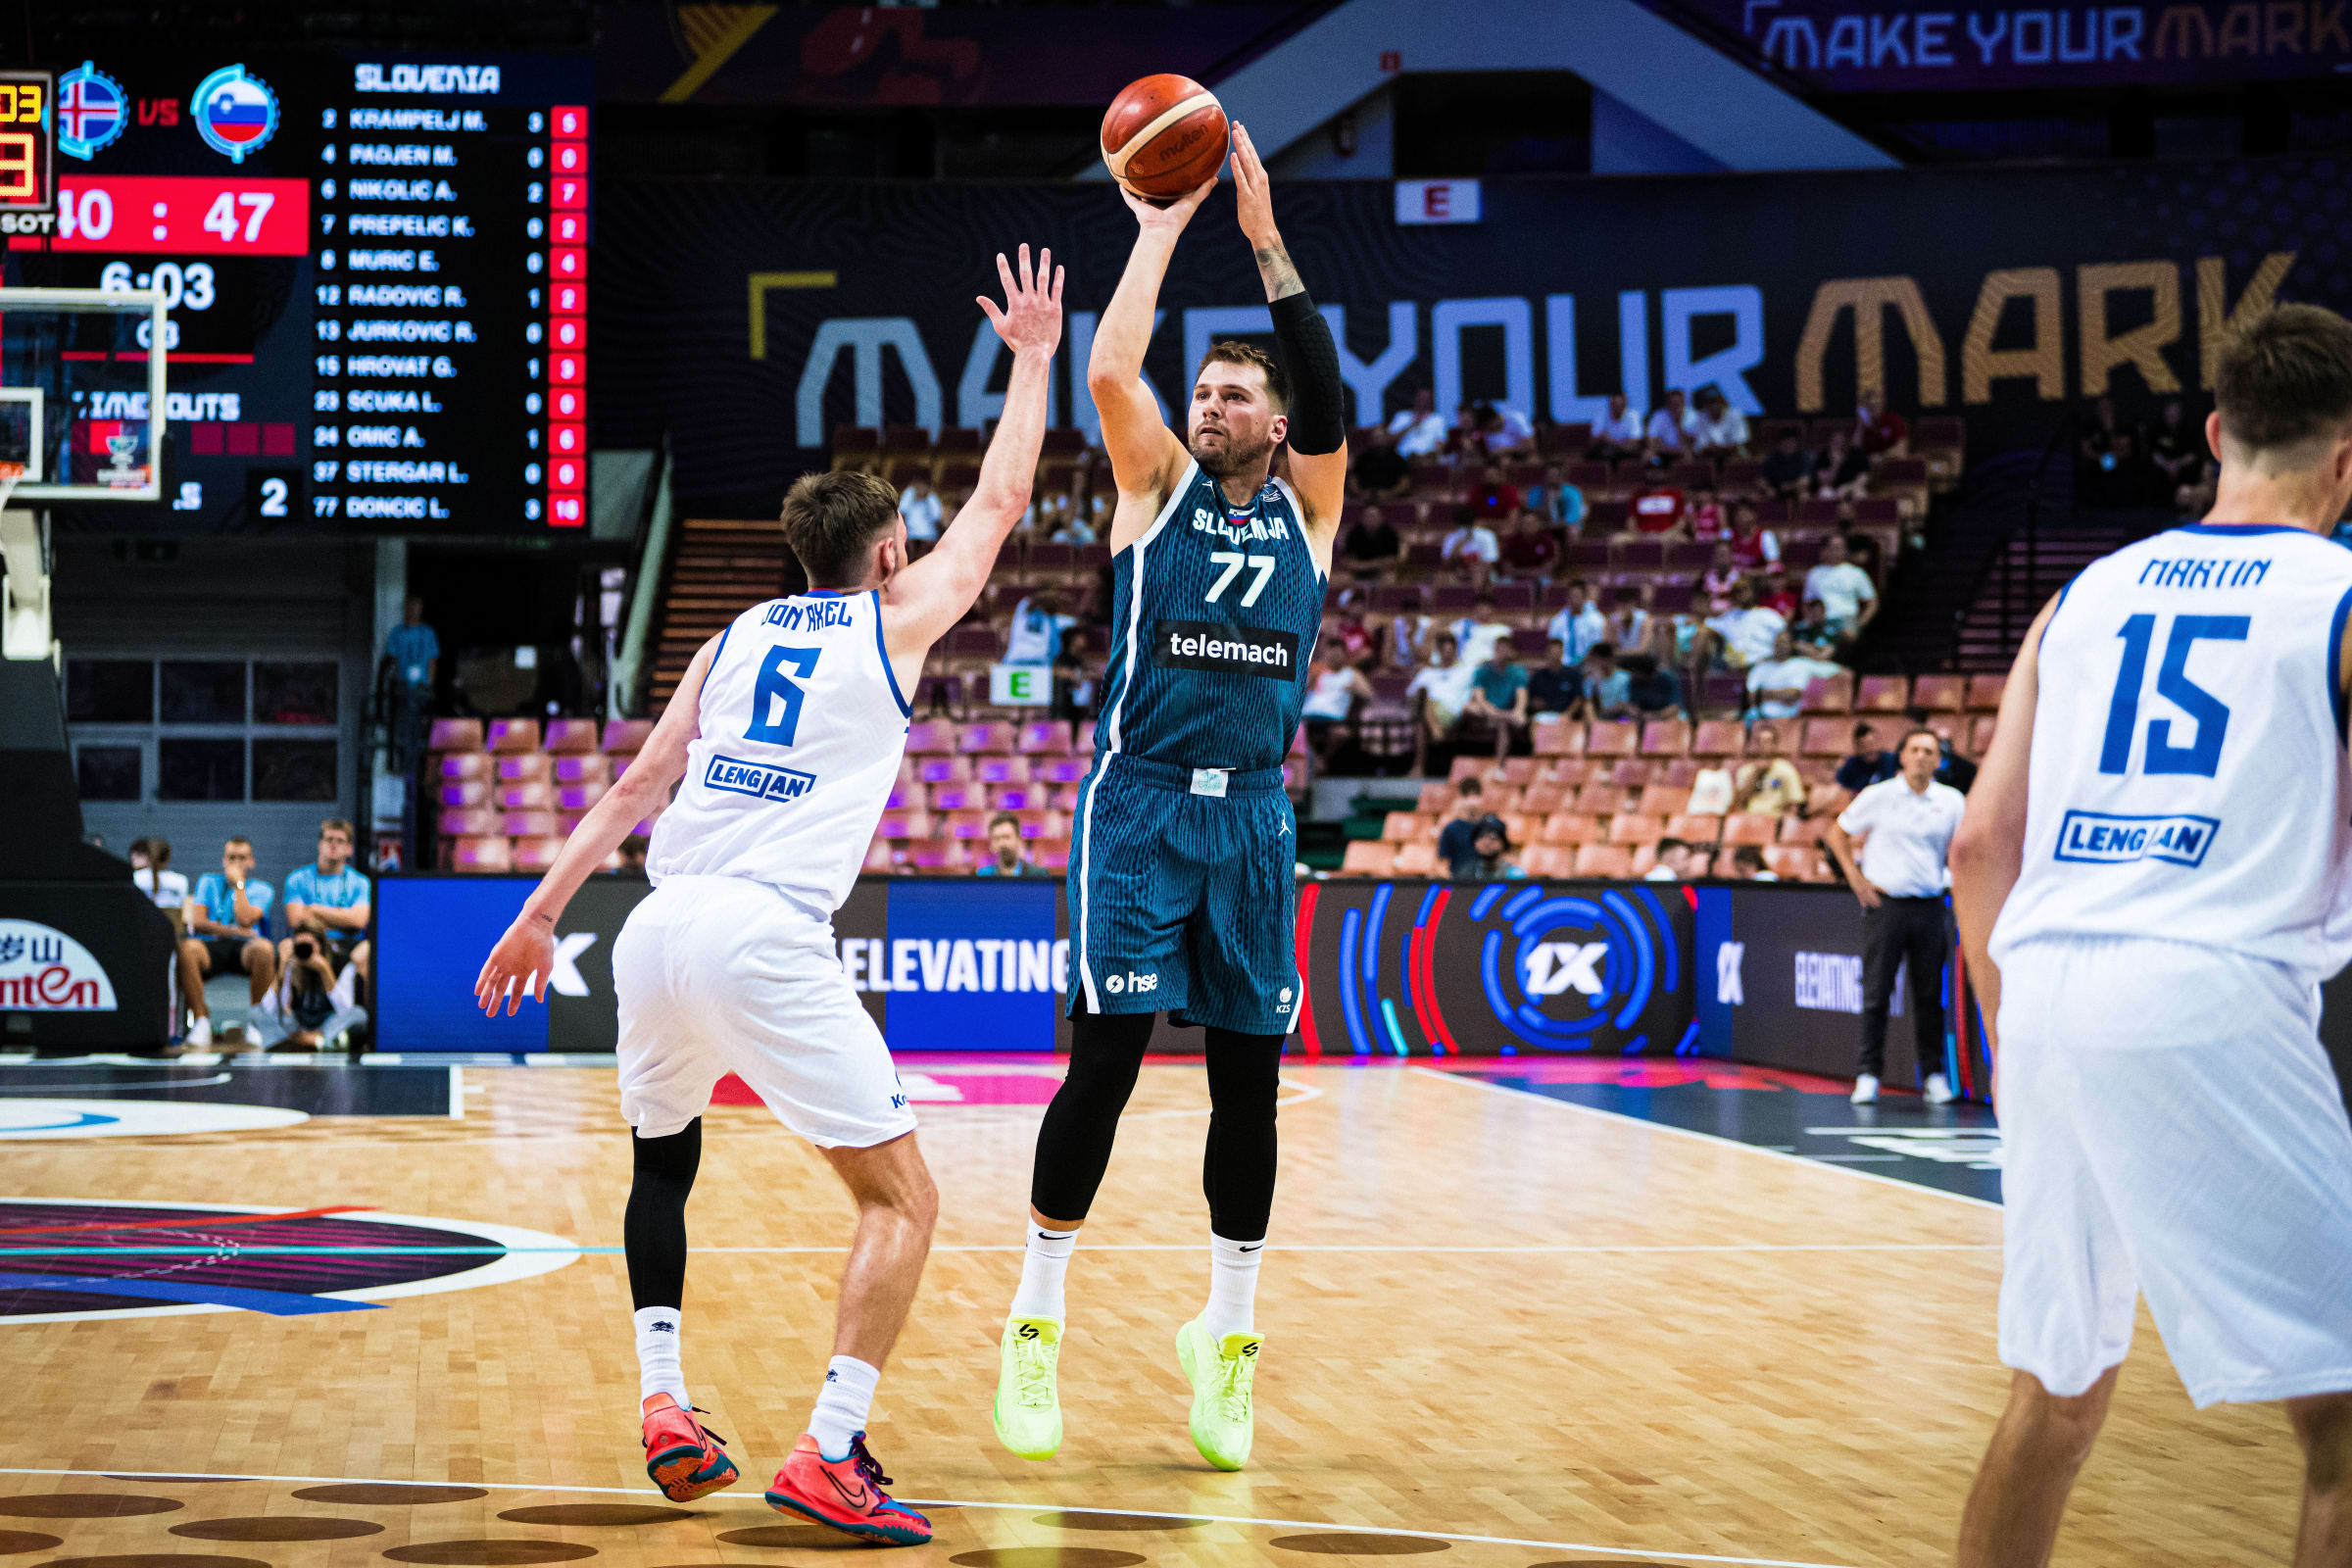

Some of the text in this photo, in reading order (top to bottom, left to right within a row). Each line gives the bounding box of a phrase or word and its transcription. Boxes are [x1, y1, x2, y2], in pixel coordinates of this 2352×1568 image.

[1764, 3, 2351, 68] MAKE YOUR MARK
[355, 64, 500, 94] SLOVENIA
[137, 98, 180, 126] VS
[321, 144, 336, 164] 4
[1160, 123, 1209, 162] molten
[349, 179, 432, 201] NIKOLIC
[434, 180, 457, 201] A.
[564, 183, 574, 200] 7
[1425, 186, 1449, 217] E
[204, 191, 275, 242] 47
[321, 215, 335, 234] 7
[349, 215, 450, 236] PREPELIC
[452, 217, 474, 236] K.
[349, 250, 416, 270] MURIC
[418, 251, 439, 271] E.
[100, 262, 216, 311] 6:03
[348, 285, 442, 307] RADOVIC
[528, 288, 539, 308] 1
[347, 320, 452, 342] JURKOVIC
[1317, 285, 1764, 428] YOUR
[1795, 252, 2296, 412] MARK
[348, 356, 431, 376] HROVAT
[527, 359, 539, 378] 1
[347, 390, 419, 412] SCUKA
[422, 392, 442, 412] L.
[403, 426, 425, 447] A.
[527, 429, 538, 449] 1
[448, 463, 468, 483] L.
[260, 477, 288, 517] 2
[314, 497, 339, 516] 77
[346, 497, 426, 518] DONCIC
[429, 498, 449, 518] L.
[1204, 551, 1276, 608] 77
[2137, 559, 2272, 587] MARTIN
[760, 601, 853, 632] JON AXEL
[1170, 633, 1289, 667] telemach
[742, 644, 822, 748] 6
[1010, 671, 1031, 699] E
[2098, 613, 2252, 778] 15
[711, 763, 806, 799] LENGJAN
[2070, 823, 2203, 855] LENGAN
[1128, 970, 1158, 993] hse
[1276, 1004, 1291, 1013] KZS
